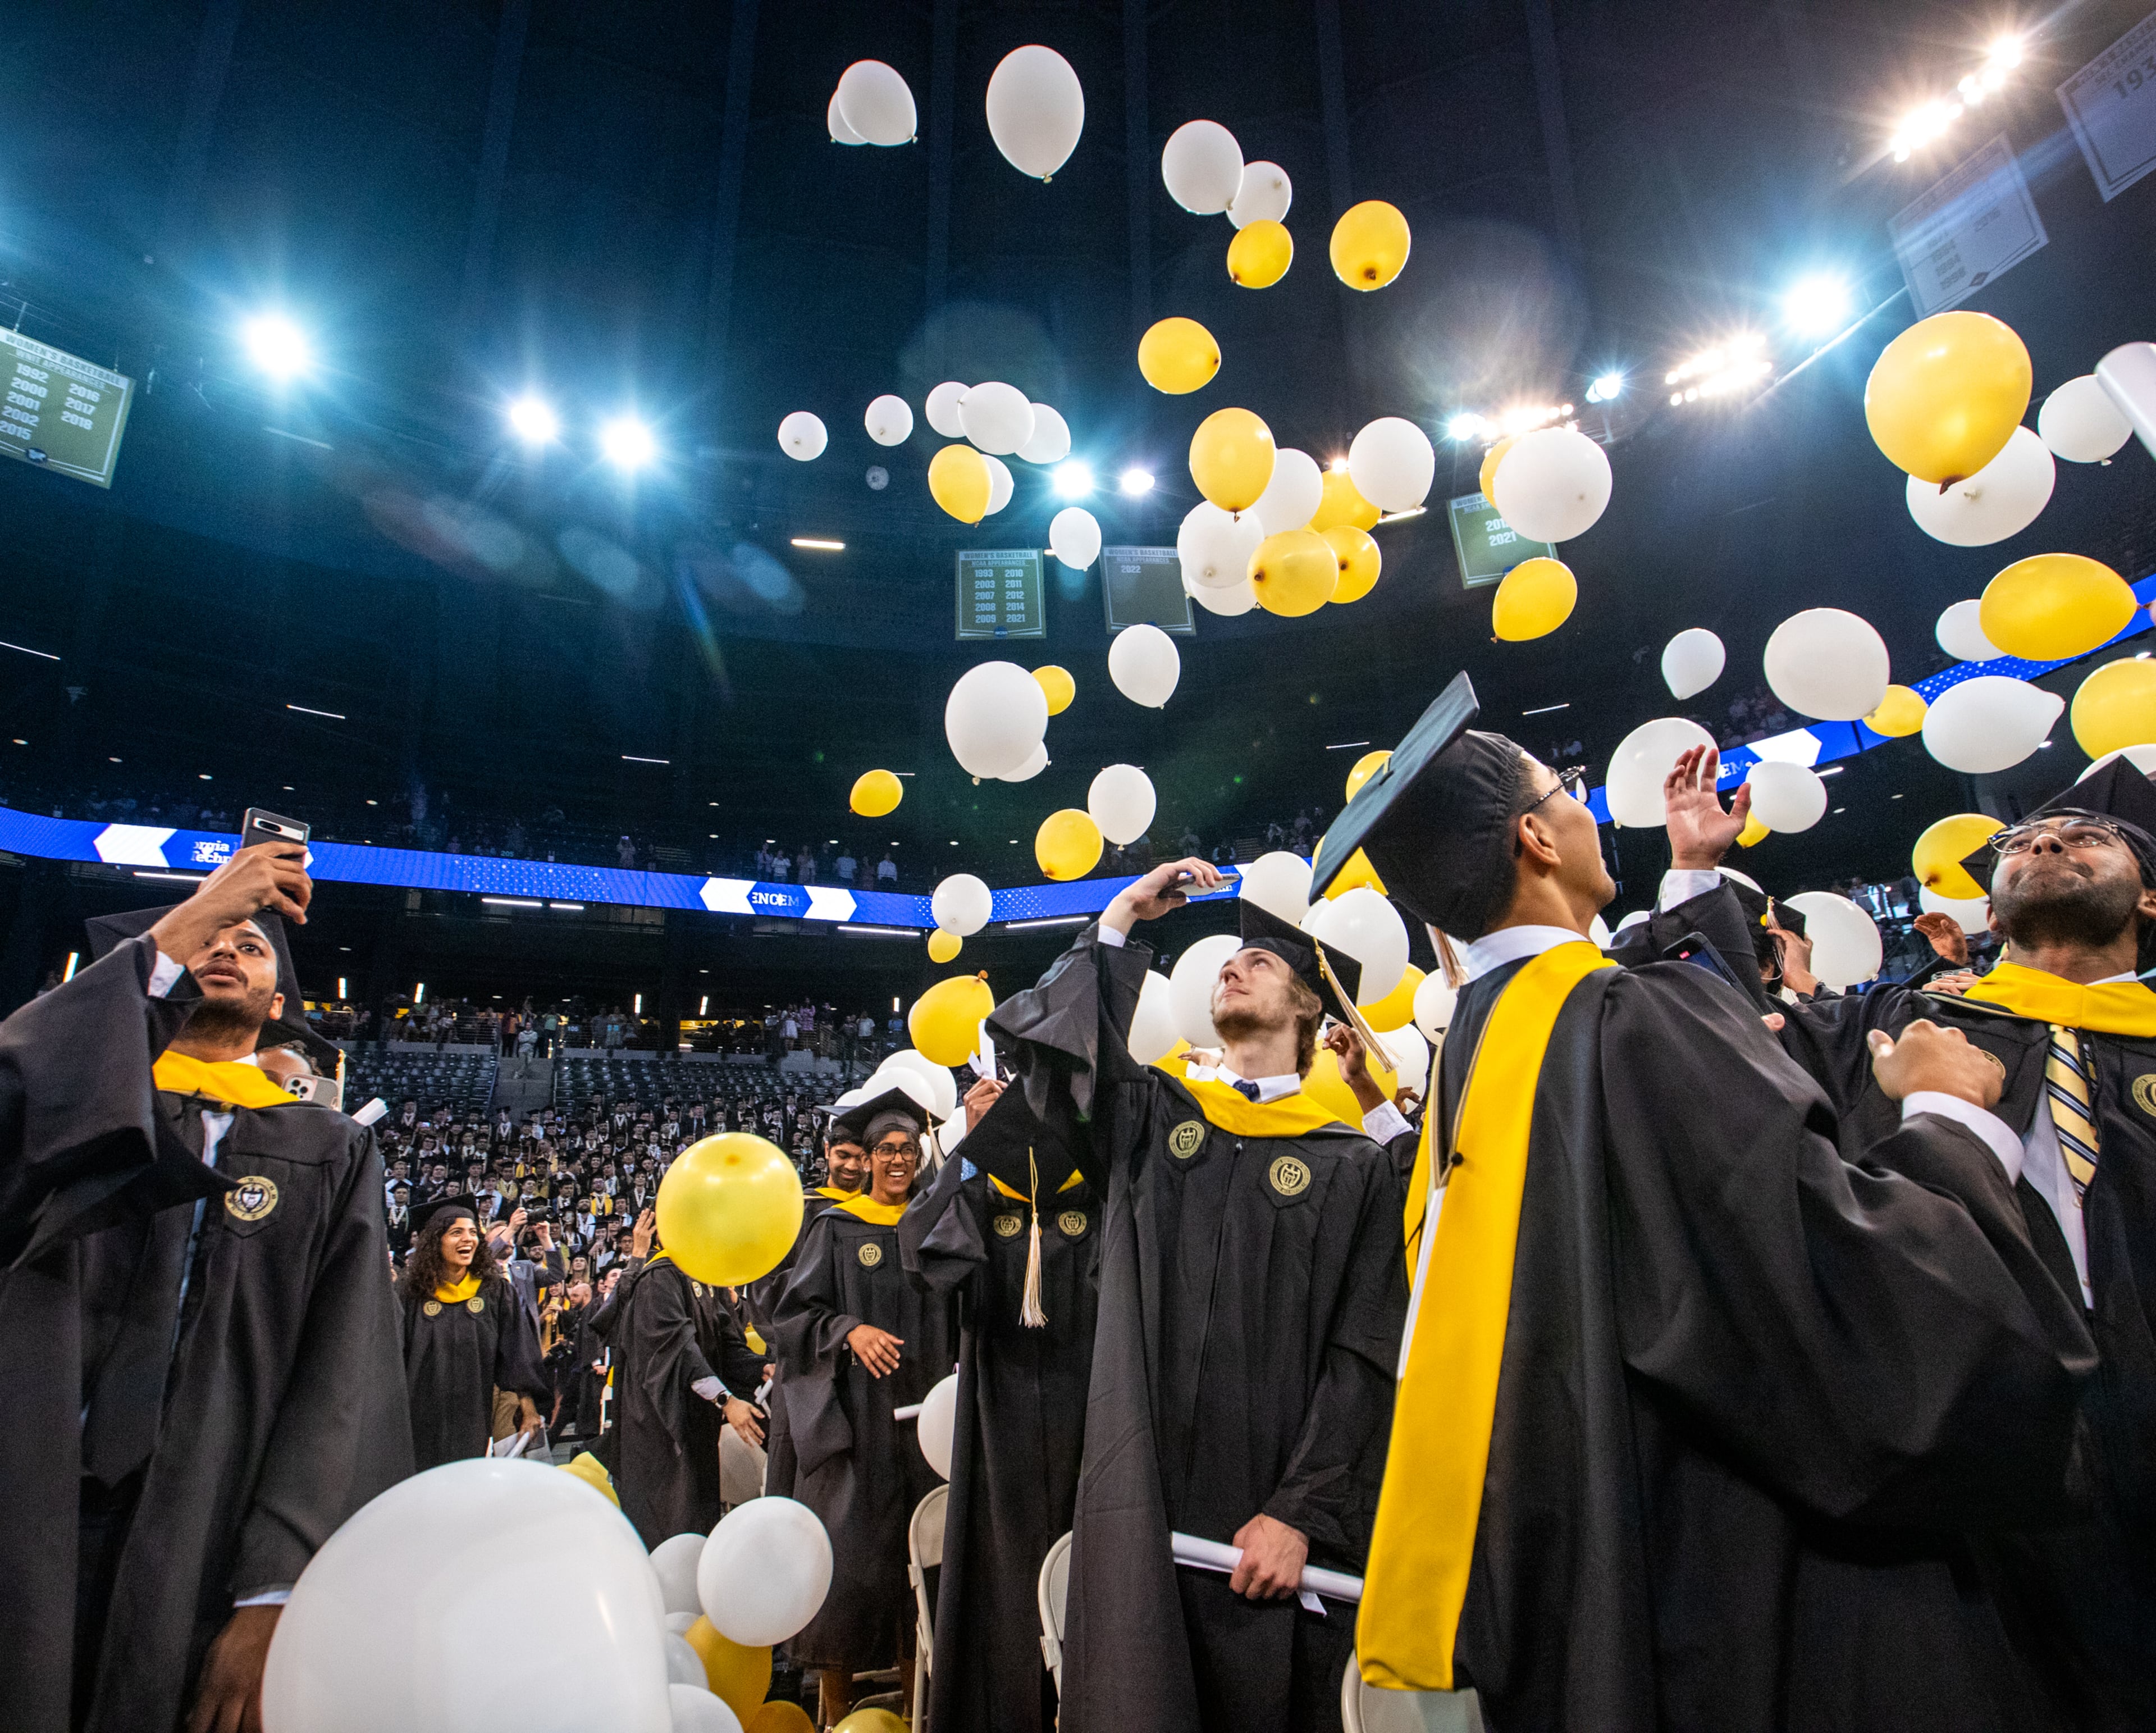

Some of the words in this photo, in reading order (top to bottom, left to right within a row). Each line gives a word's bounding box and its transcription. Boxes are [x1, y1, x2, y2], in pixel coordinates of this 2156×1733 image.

[16, 362, 49, 384] 1992
[11, 377, 48, 398] 2000
[68, 382, 101, 403] 2016
[6, 391, 40, 412] 2001
[64, 396, 97, 415] 2017
[1, 405, 40, 427] 2002
[61, 411, 94, 430] 2018
[0, 420, 33, 440] 2015
[1485, 518, 1509, 532] 201
[1488, 530, 1516, 547] 2021
[975, 569, 993, 577] 1993
[1005, 569, 1024, 577] 2010
[975, 580, 995, 589] 2003
[975, 591, 995, 600] 2007
[975, 603, 996, 612] 2008
[975, 614, 997, 623] 2009
[1006, 614, 1026, 622] 2021
